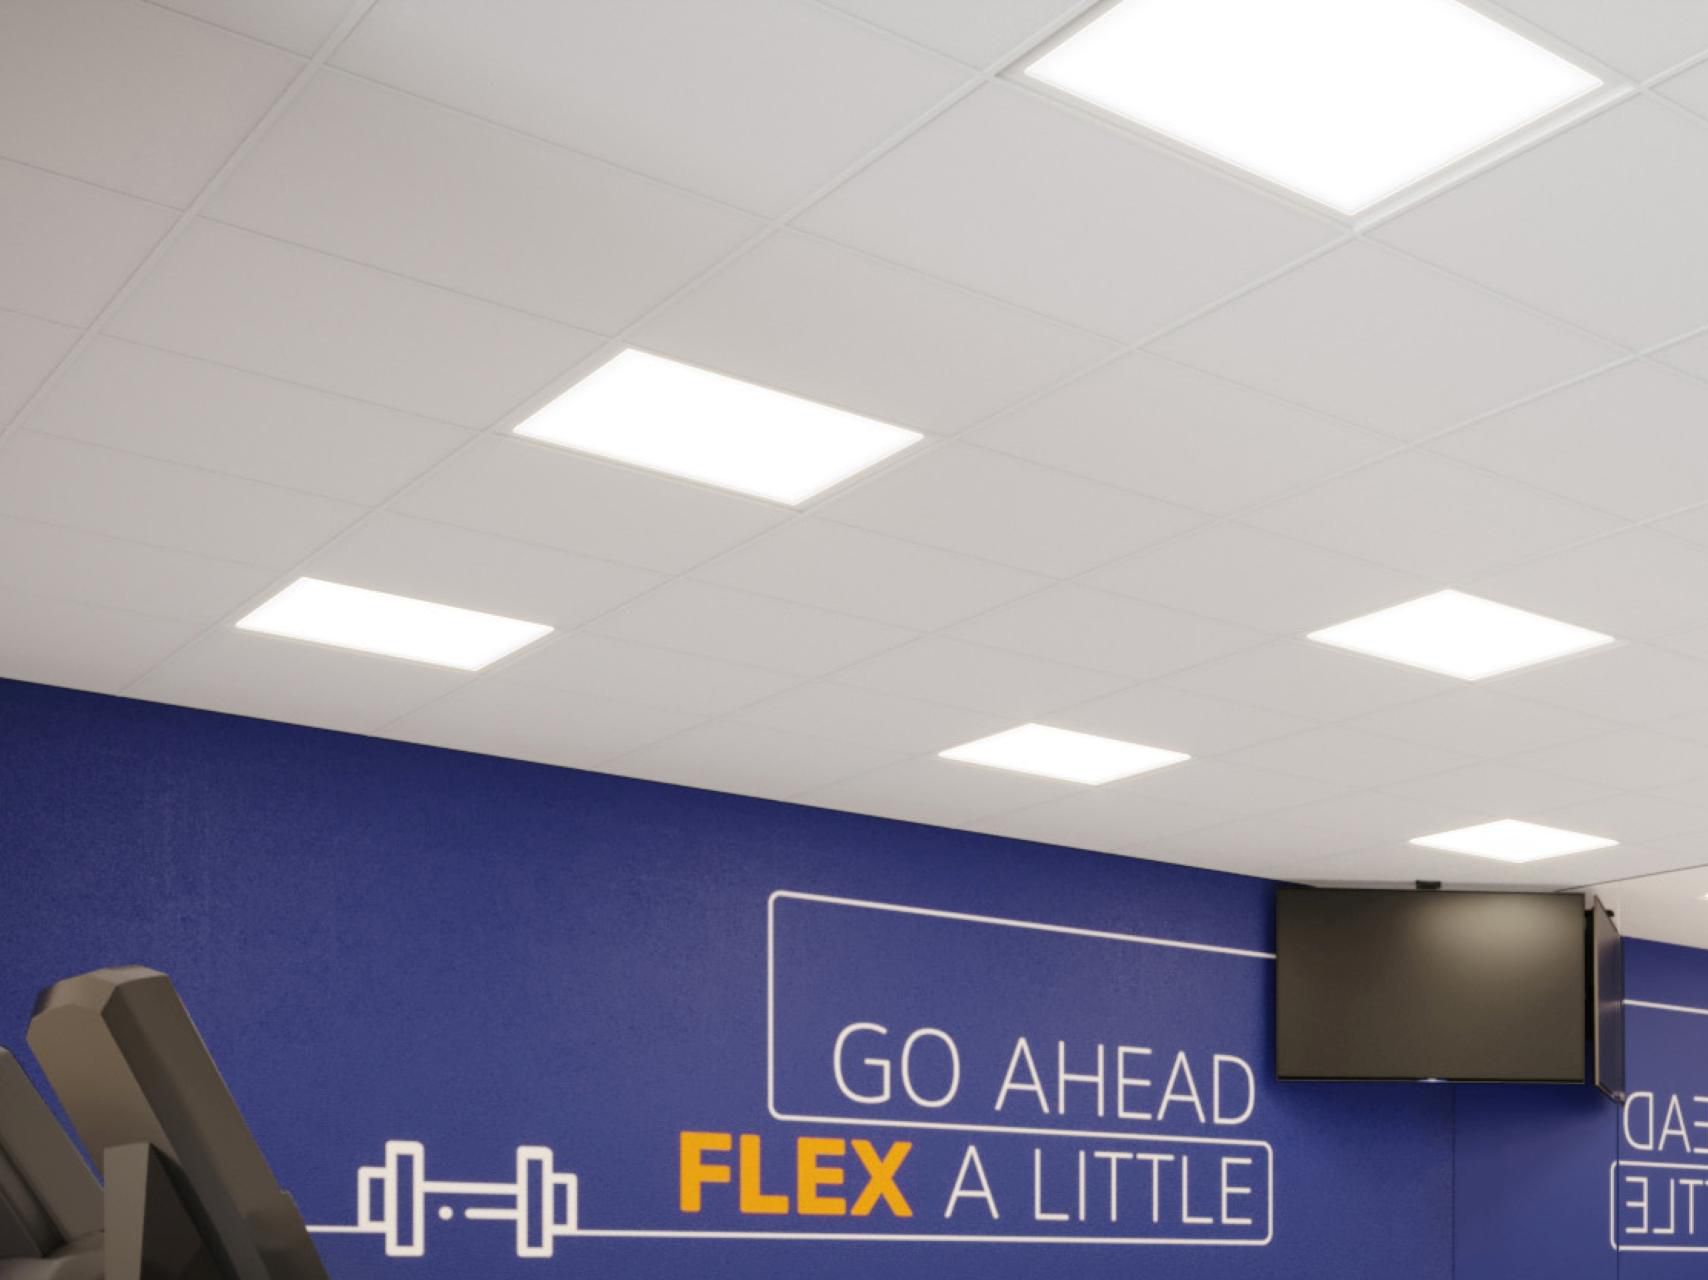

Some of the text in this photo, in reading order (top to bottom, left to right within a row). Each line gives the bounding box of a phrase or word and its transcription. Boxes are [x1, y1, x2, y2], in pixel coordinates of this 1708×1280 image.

[832, 1022, 1256, 1126] GO AHEAD
[678, 1130, 1253, 1226] FLEX A LITTLE
